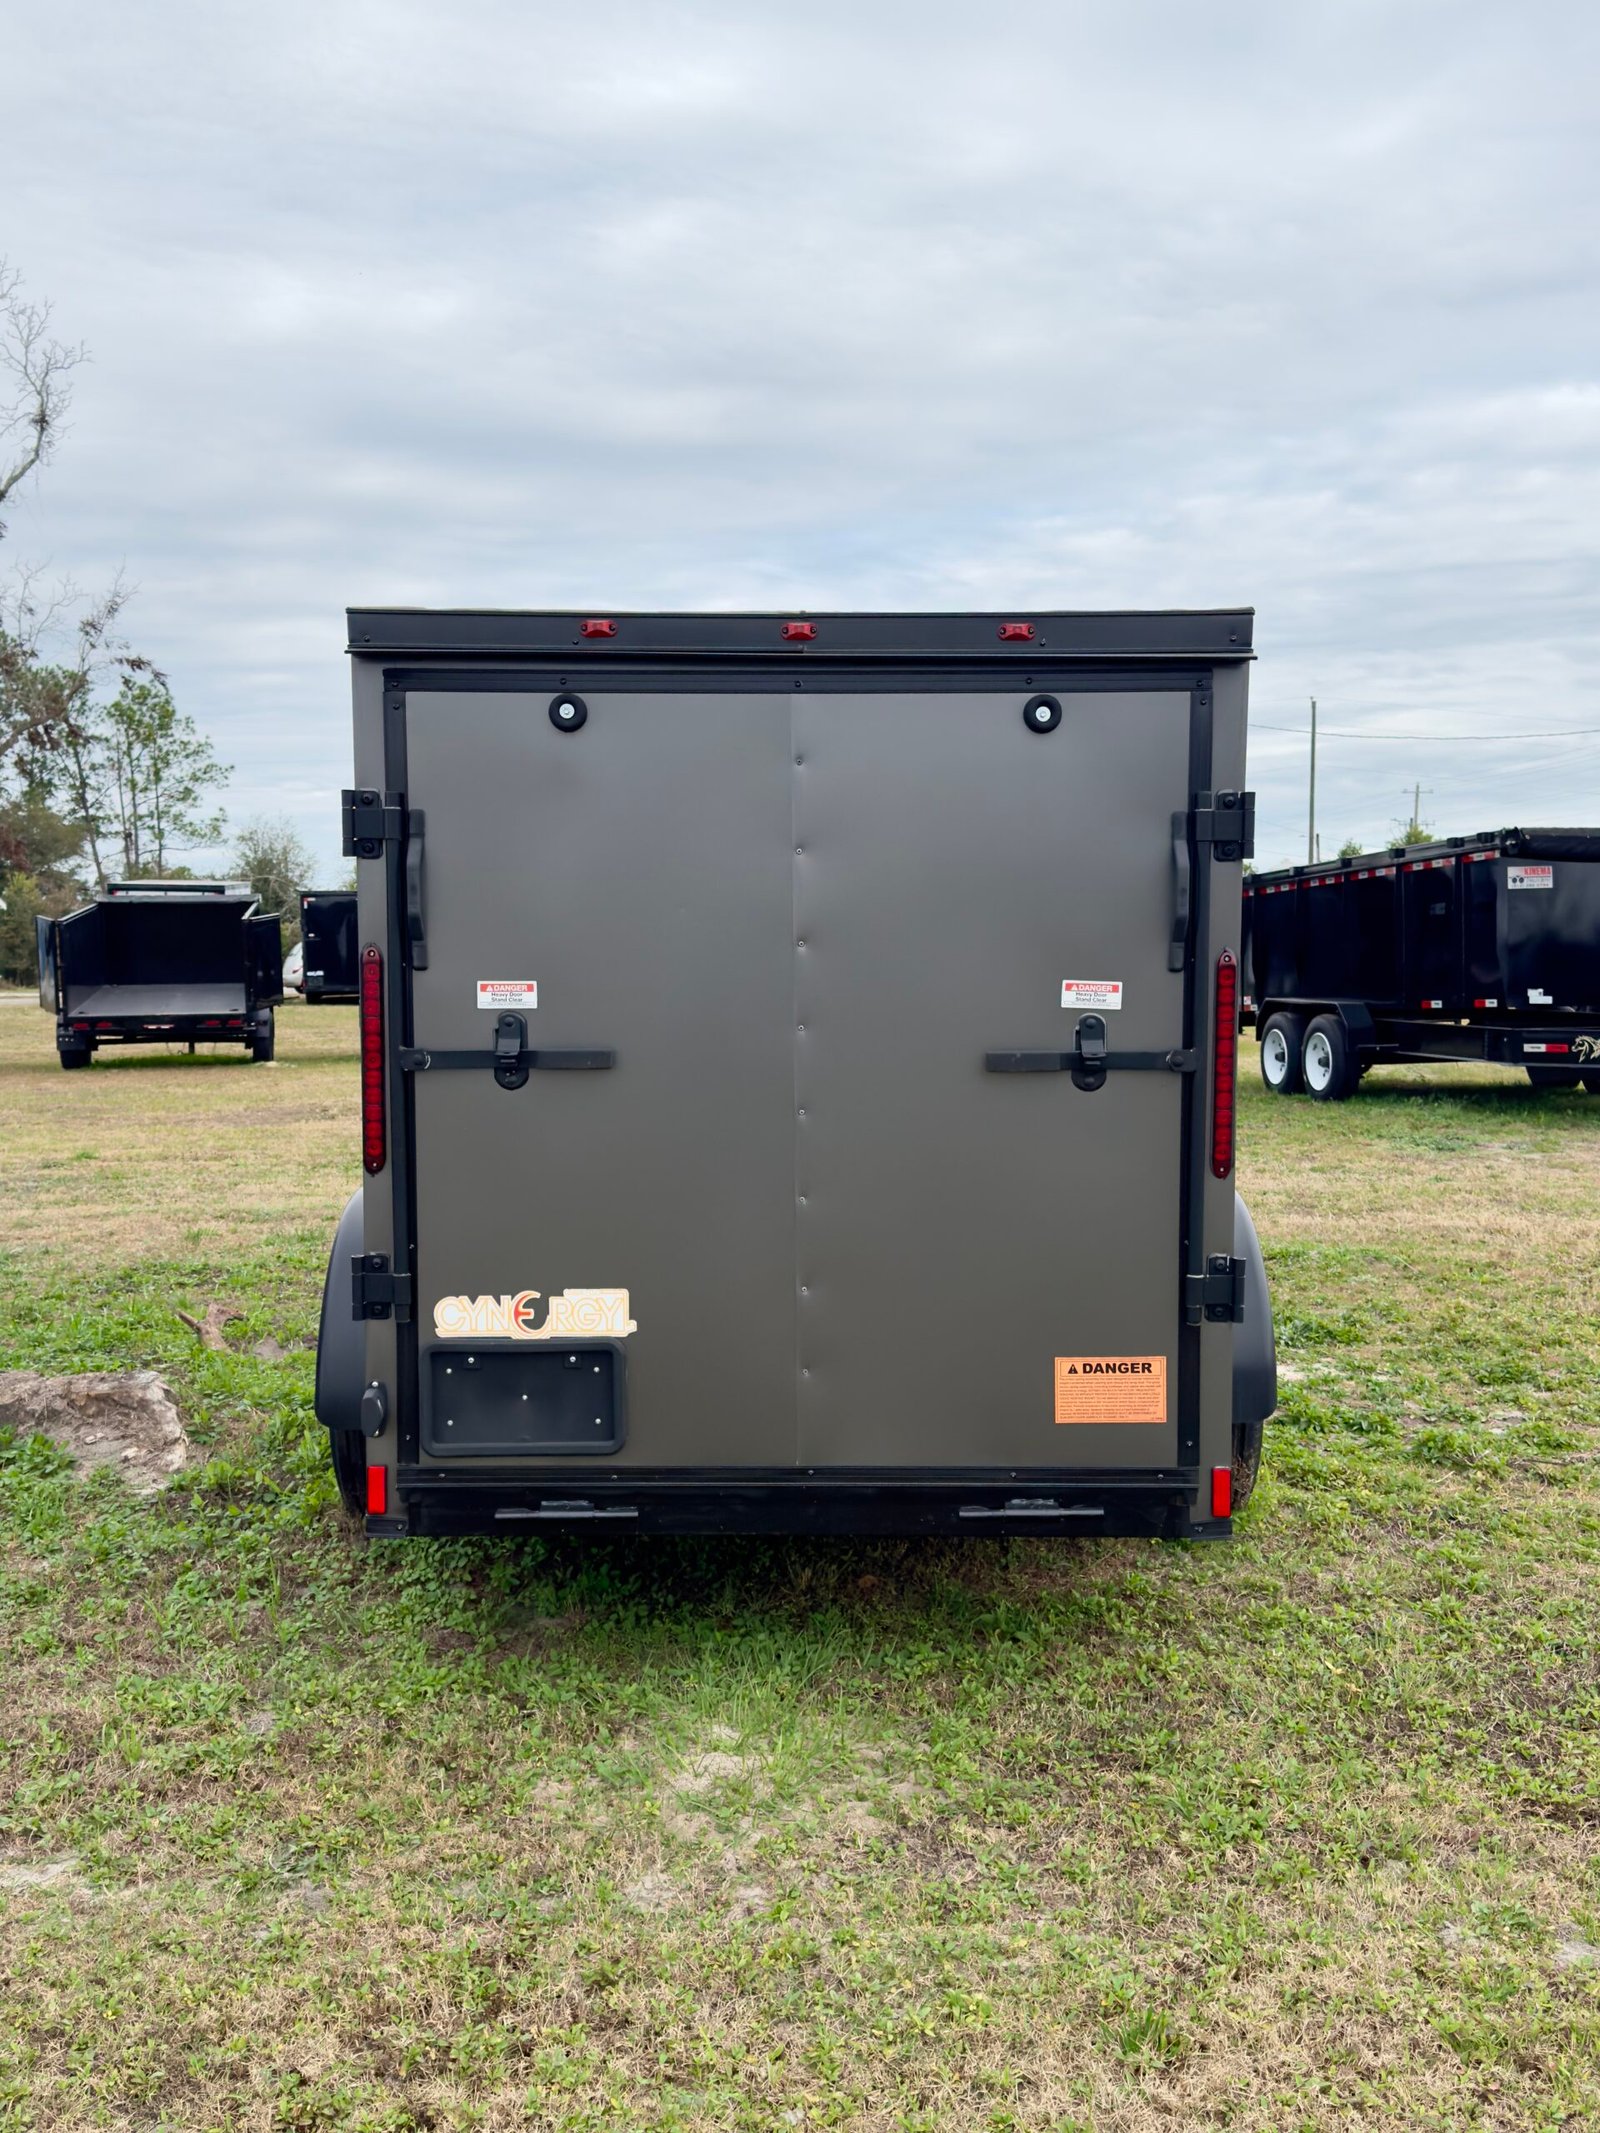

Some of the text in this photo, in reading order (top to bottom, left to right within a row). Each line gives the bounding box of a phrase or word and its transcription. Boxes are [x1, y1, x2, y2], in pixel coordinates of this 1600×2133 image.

[493, 984, 528, 992] DANGER
[1078, 984, 1113, 992] DANGER
[435, 1290, 627, 1339] CYNERGY
[1082, 1362, 1152, 1374] DANGER
